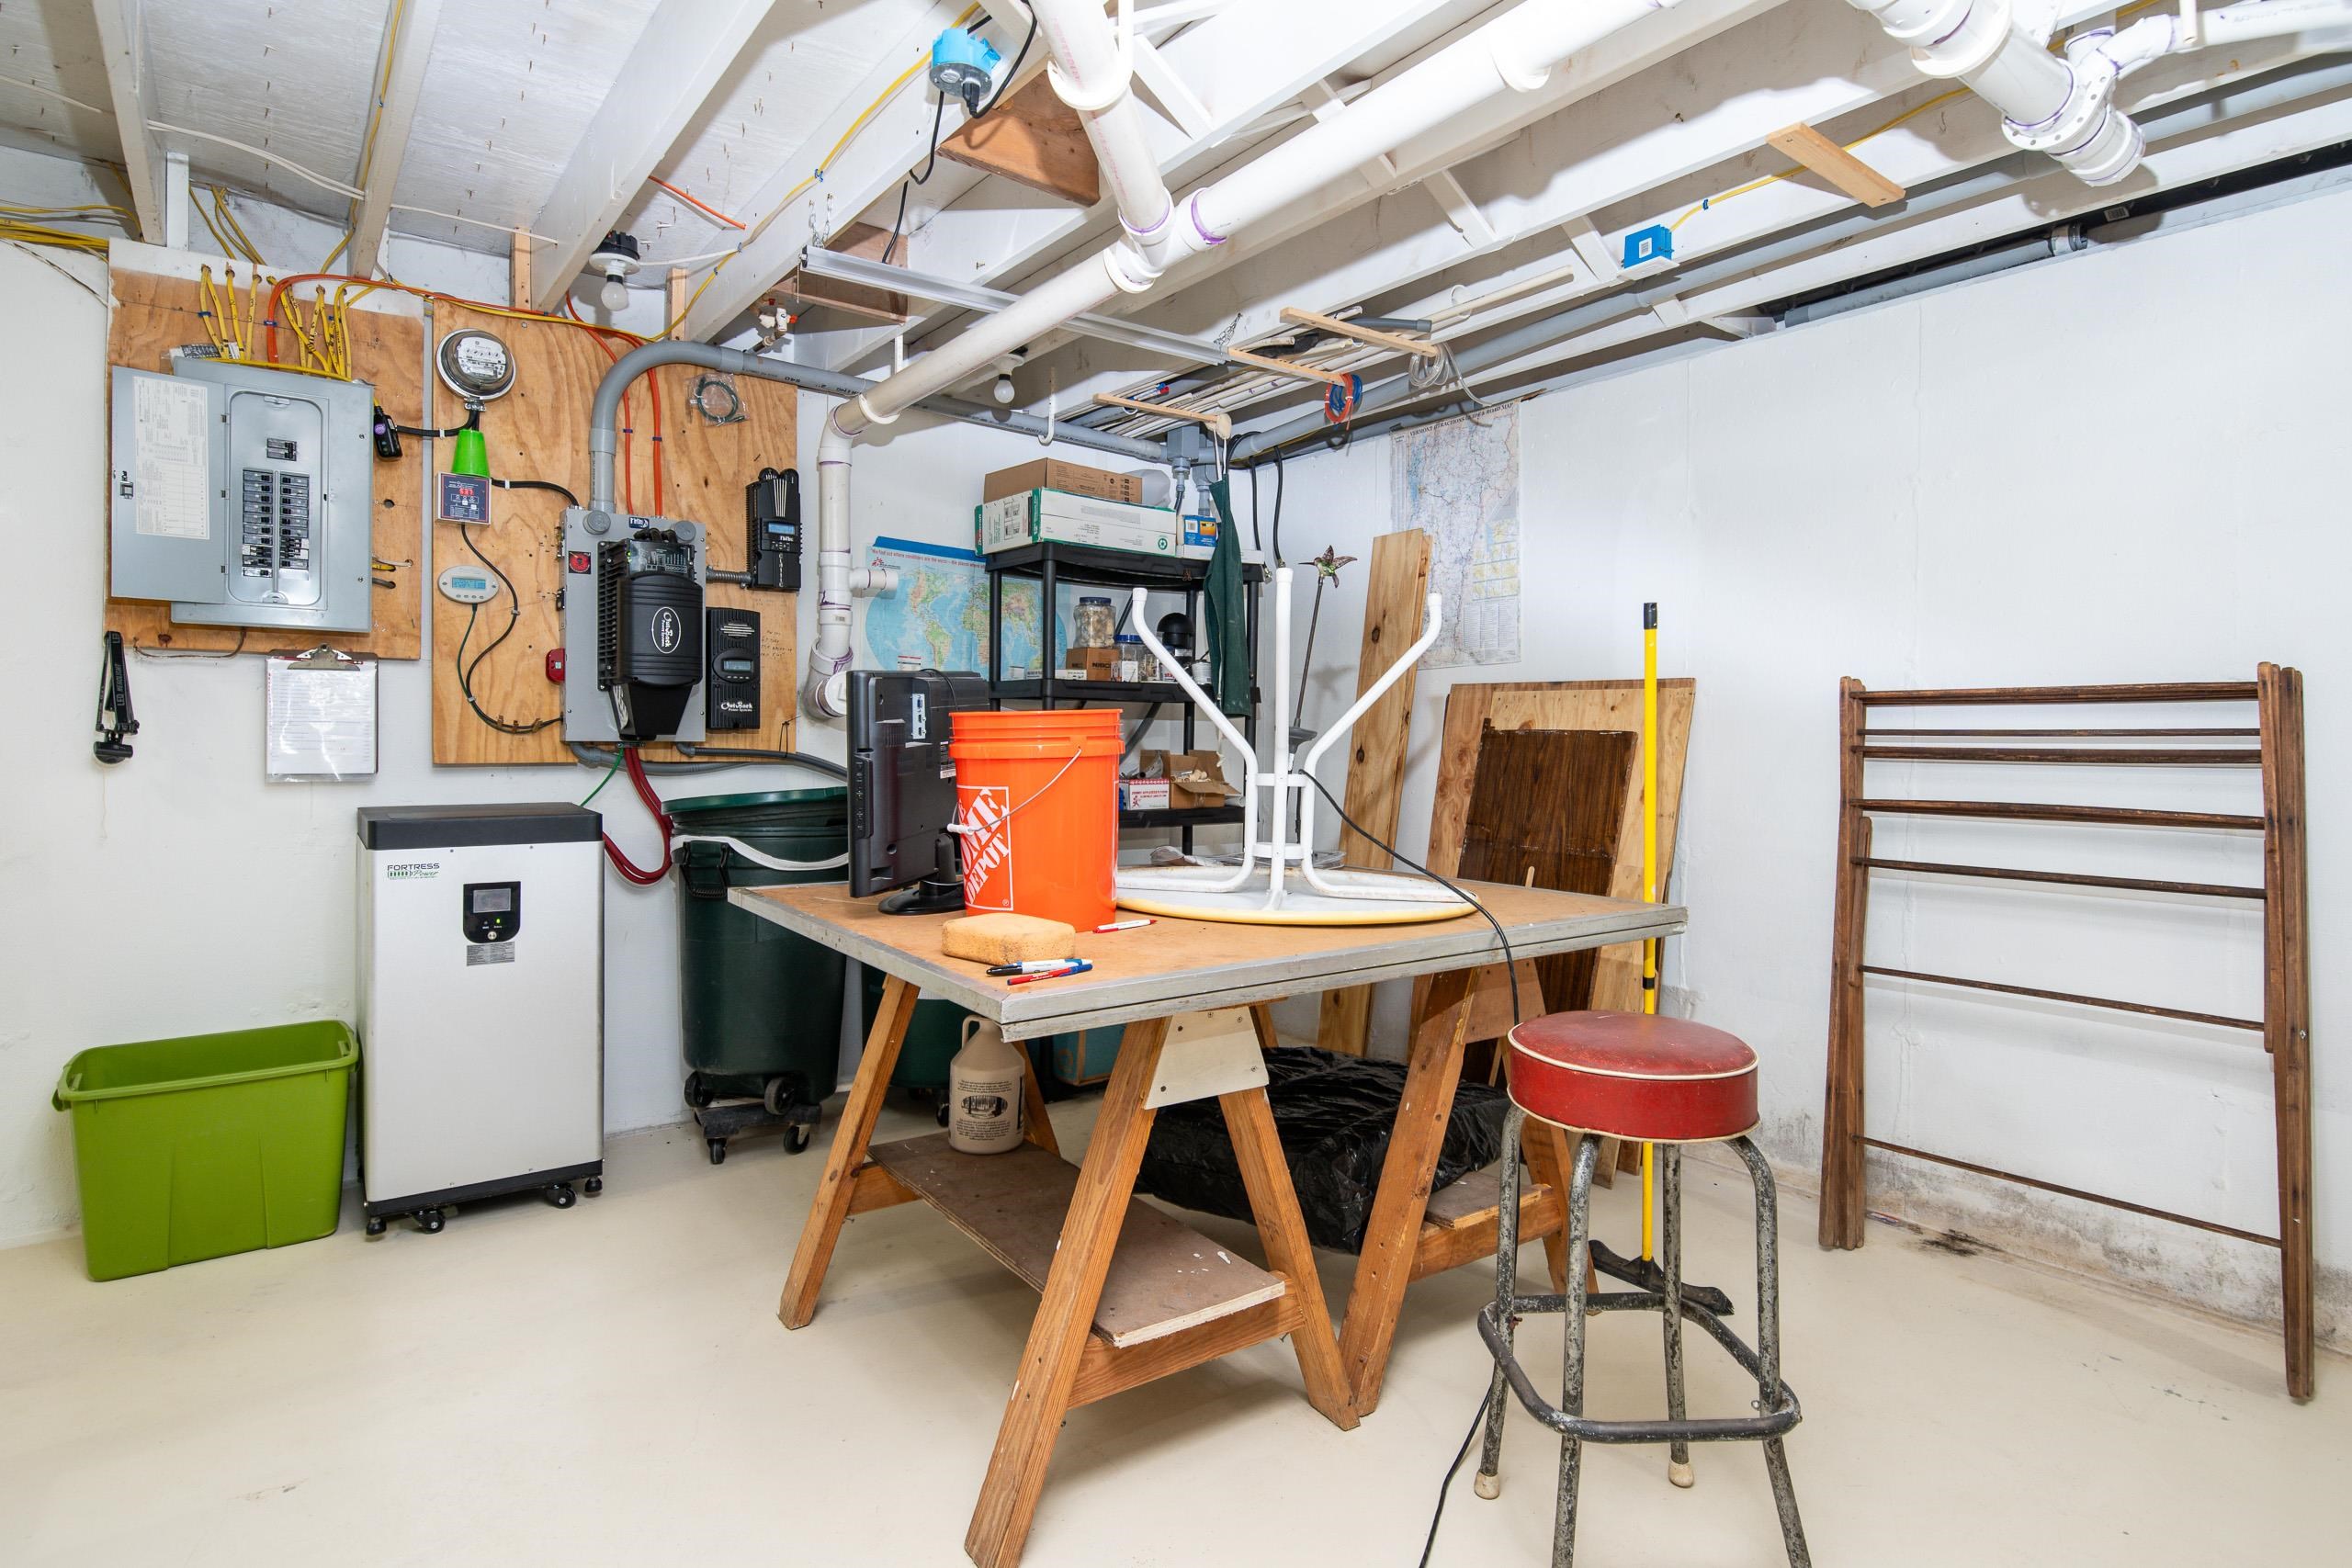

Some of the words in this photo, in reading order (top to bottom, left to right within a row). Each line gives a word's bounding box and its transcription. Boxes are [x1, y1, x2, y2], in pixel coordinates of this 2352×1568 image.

[1409, 426, 1433, 436] VERMONT
[1486, 406, 1501, 414] ROAD
[1501, 402, 1514, 411] MAP
[387, 863, 440, 871] FORTRESS
[966, 832, 1010, 905] DEPOT
